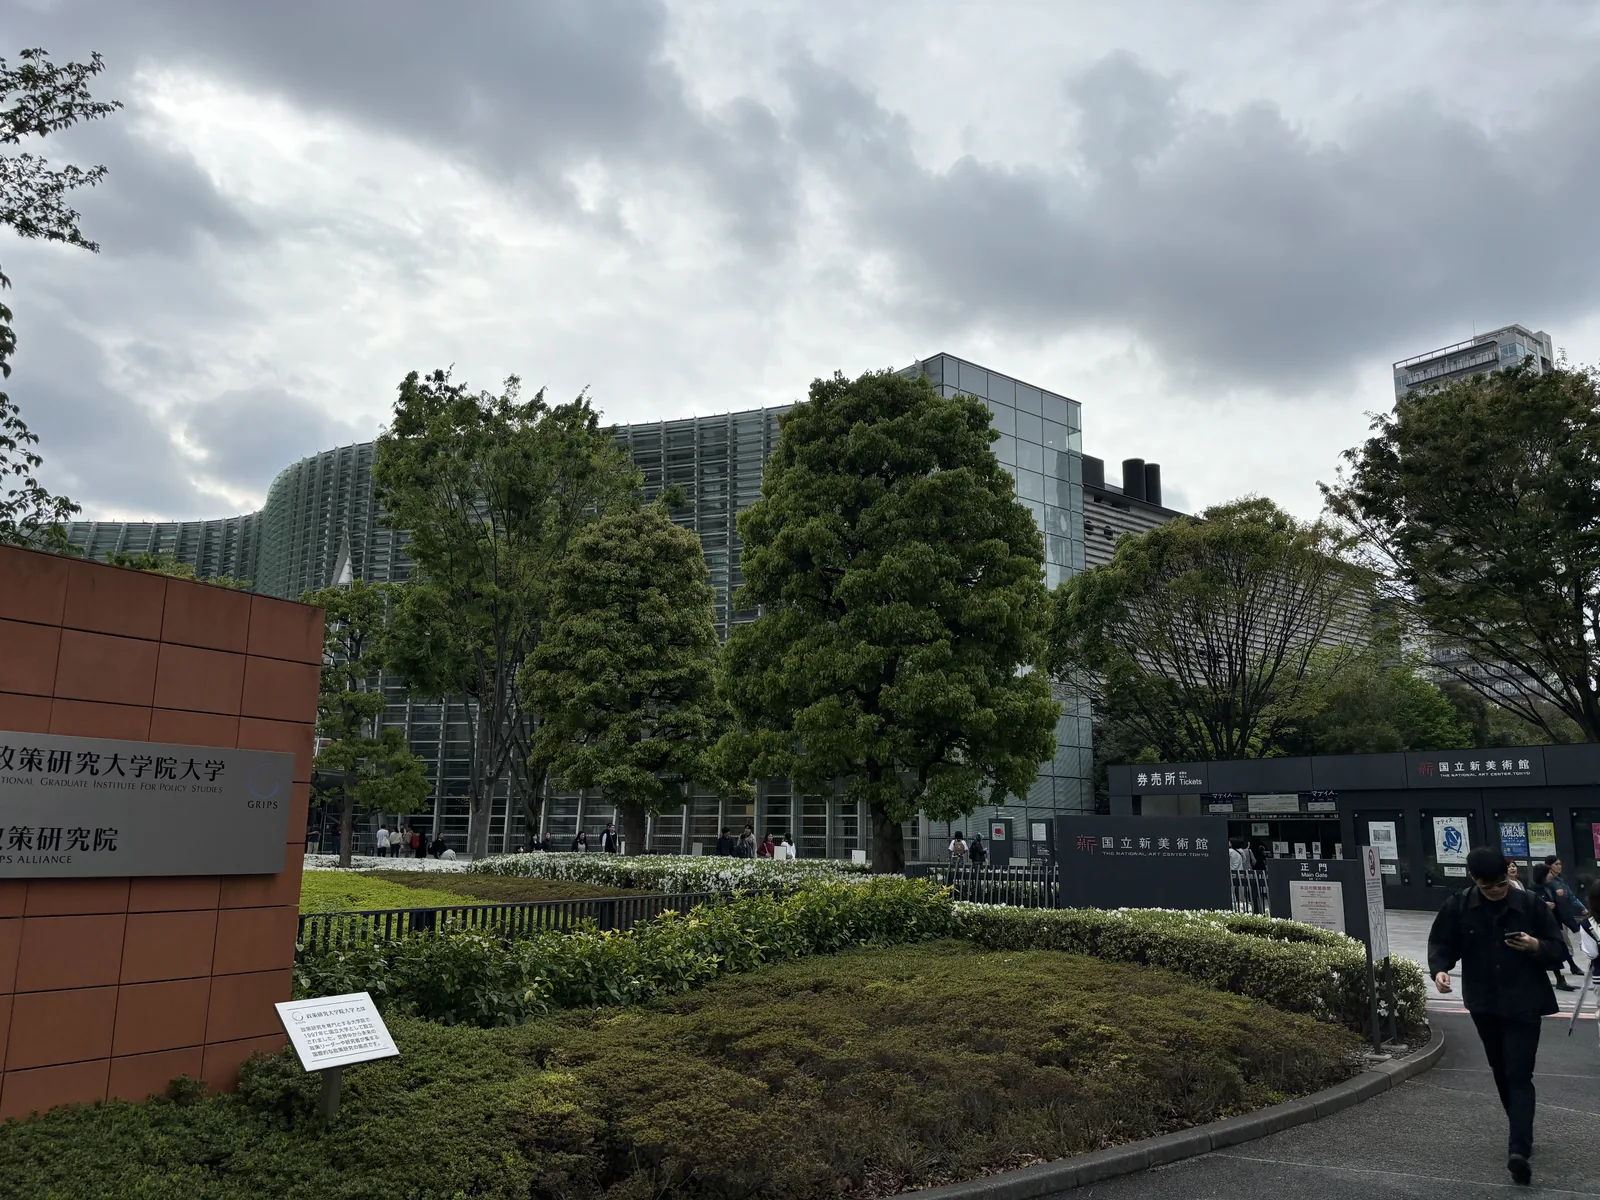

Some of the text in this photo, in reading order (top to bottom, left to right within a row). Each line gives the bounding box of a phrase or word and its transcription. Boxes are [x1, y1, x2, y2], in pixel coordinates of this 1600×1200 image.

[1439, 759, 1530, 772] 国立新美術館
[40, 777, 88, 788] GRADUATE
[93, 780, 136, 790] INSTITUTE
[140, 782, 156, 791] FOR
[159, 784, 187, 793] POLICY
[191, 785, 223, 794] STUDIES
[1137, 772, 1176, 787] 券売所
[1179, 778, 1203, 786] Tickets
[247, 800, 279, 809] GRIPS
[0, 825, 118, 852] 策研究院
[1101, 836, 1209, 850] 国立新美術館
[17, 855, 72, 864] ALLIANCE
